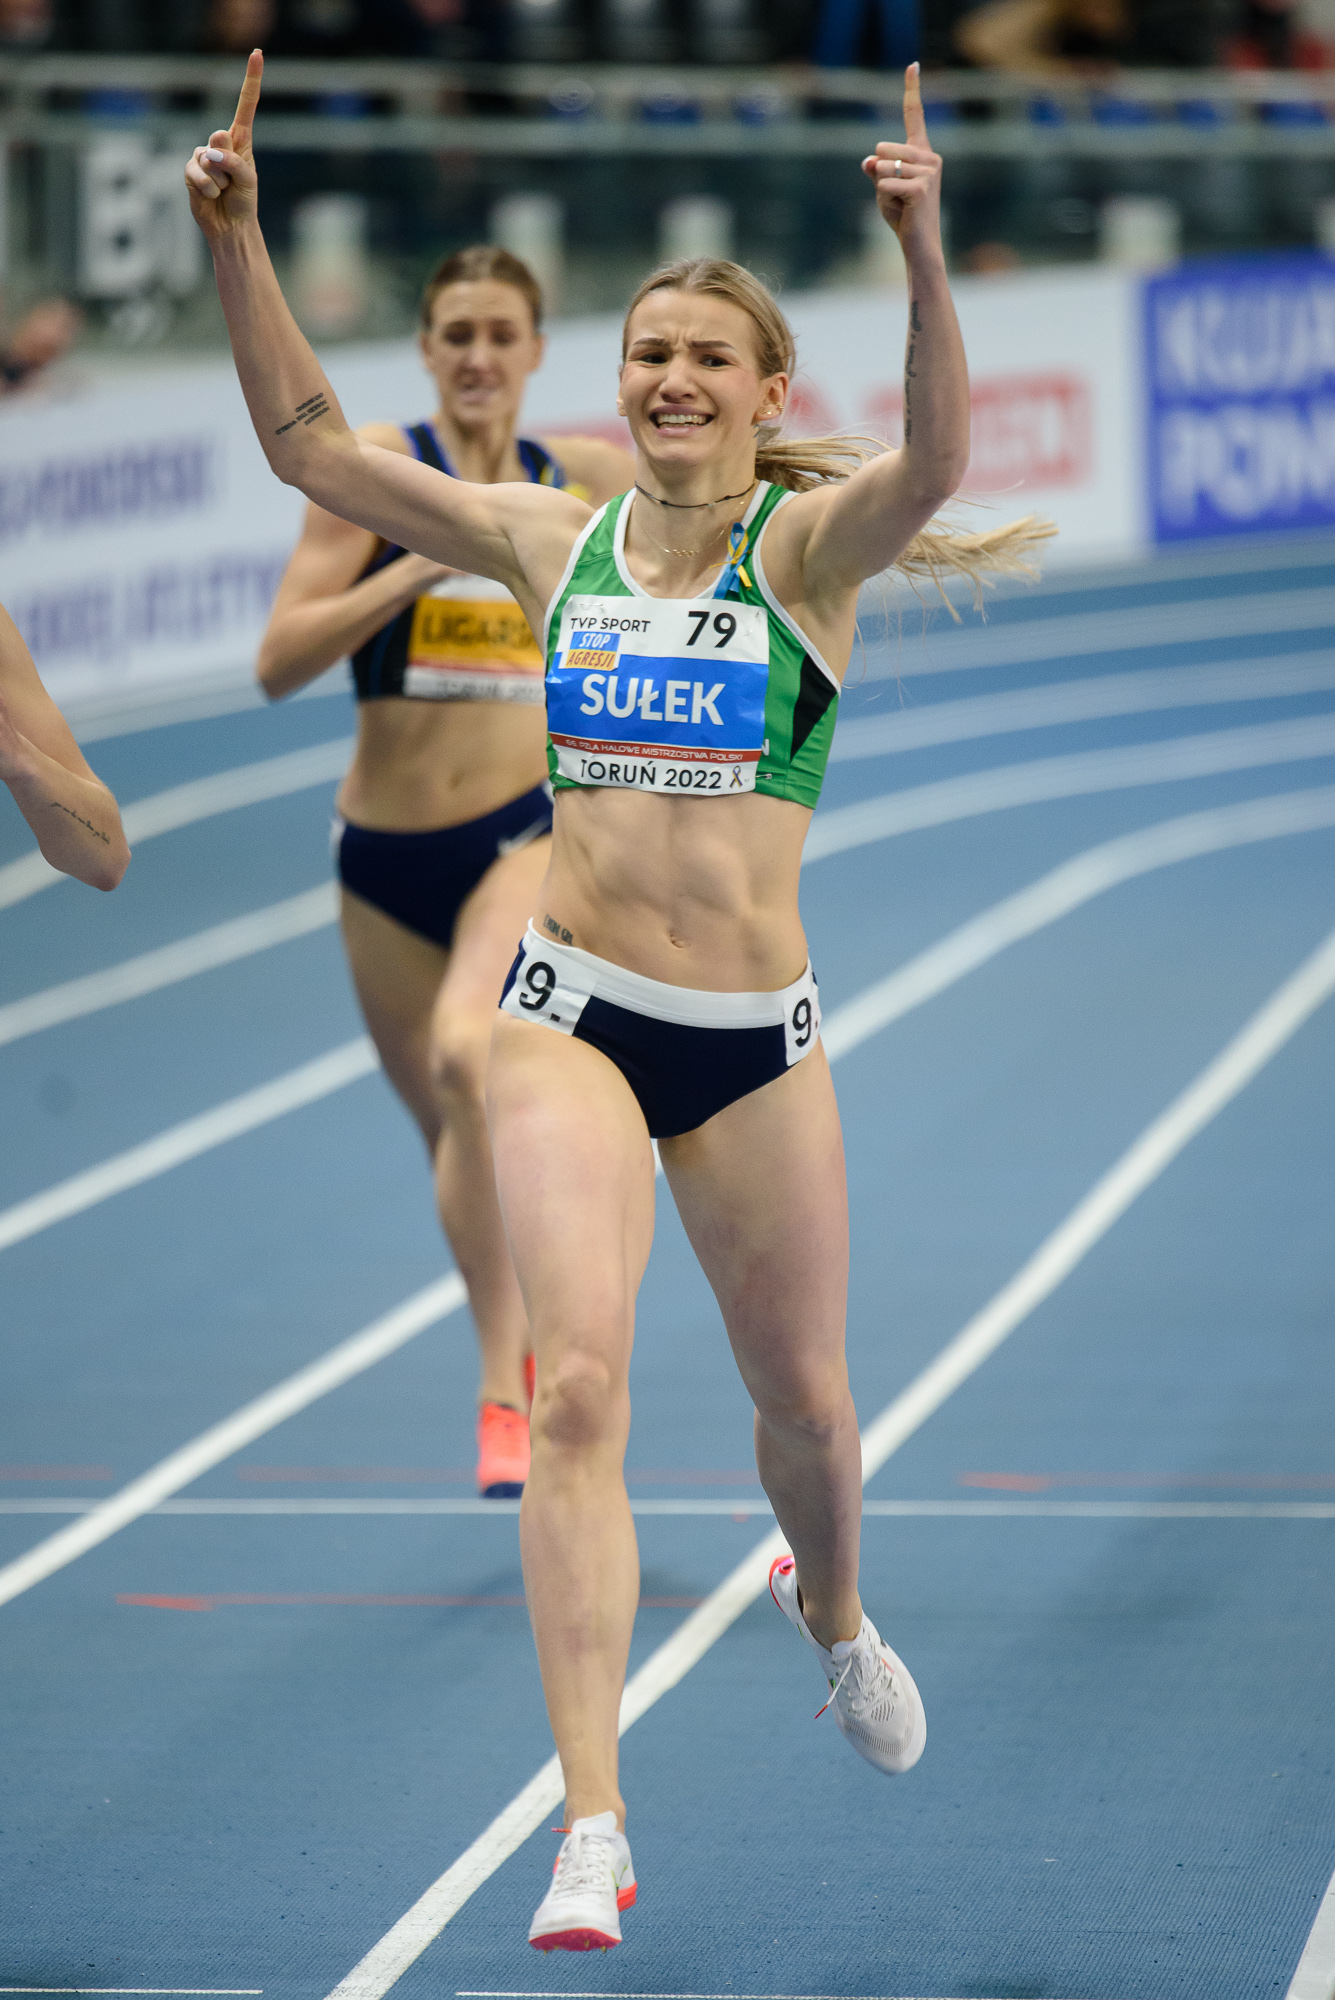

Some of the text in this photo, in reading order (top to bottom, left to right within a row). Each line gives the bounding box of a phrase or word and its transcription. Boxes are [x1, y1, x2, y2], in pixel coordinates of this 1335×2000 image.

[570, 617, 651, 633] TVP SPORT
[686, 611, 737, 648] 79
[578, 632, 612, 649] STOP
[565, 651, 616, 668] AGRESJI
[579, 673, 726, 726] SUŁEK
[579, 741, 599, 751] PZLA
[601, 744, 640, 755] HALOWE
[641, 747, 708, 760] MISTRZOSTWA
[710, 752, 743, 762] POLSKI
[580, 758, 722, 790] TORUŃ 2022
